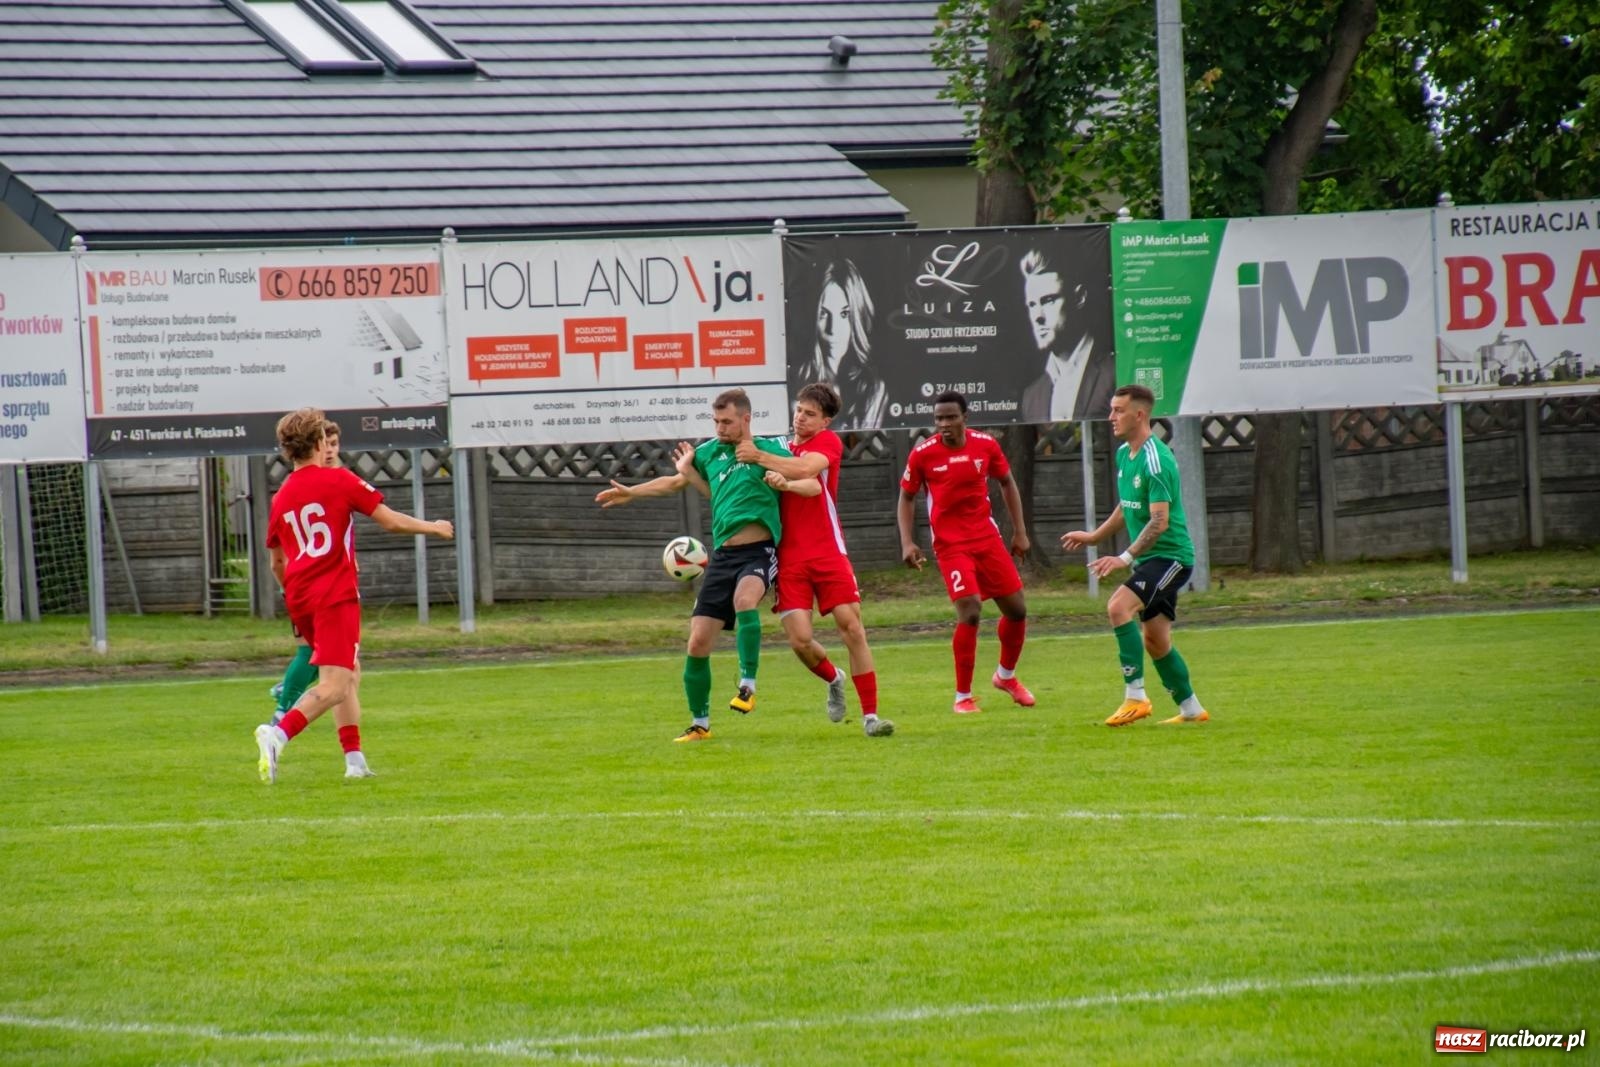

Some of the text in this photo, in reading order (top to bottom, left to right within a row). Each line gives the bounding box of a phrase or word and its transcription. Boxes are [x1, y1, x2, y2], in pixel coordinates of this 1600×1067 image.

[1451, 211, 1589, 237] RESTAURACJA
[1122, 232, 1209, 247] iMP Marcin Lasak
[99, 266, 429, 297] MR BAU Marcin Rusek 666 859 250
[463, 257, 678, 310] HOLLAND
[904, 301, 996, 315] LUIZA
[112, 314, 237, 327] kompleksowa budowa domów
[113, 333, 160, 343] rozbudowa
[167, 331, 218, 343] przebudowa
[220, 330, 262, 342] budynków
[265, 328, 322, 340] mieszkalnych
[905, 326, 997, 339] STUDIO SZTUKI FRYZJERSKIEJ
[114, 350, 150, 361] remonty
[159, 348, 214, 361] wykończenia
[1, 369, 67, 387] rusztowań
[115, 368, 135, 378] oraz
[136, 367, 155, 377] inne
[156, 366, 183, 378] usługi
[184, 365, 231, 376] remontowo
[240, 363, 286, 374] budowlane
[116, 382, 199, 396] projekty budowlane
[935, 383, 946, 395] 32
[967, 383, 976, 393] 61
[977, 382, 985, 393] 21
[3, 400, 50, 421] sprzętu
[117, 400, 194, 412] nadzór budowlany
[983, 400, 1018, 411] Tworków
[110, 430, 122, 441] 47
[129, 430, 144, 440] 451
[144, 427, 182, 440] Tworków
[283, 502, 332, 560] 16
[951, 570, 965, 592] 2
